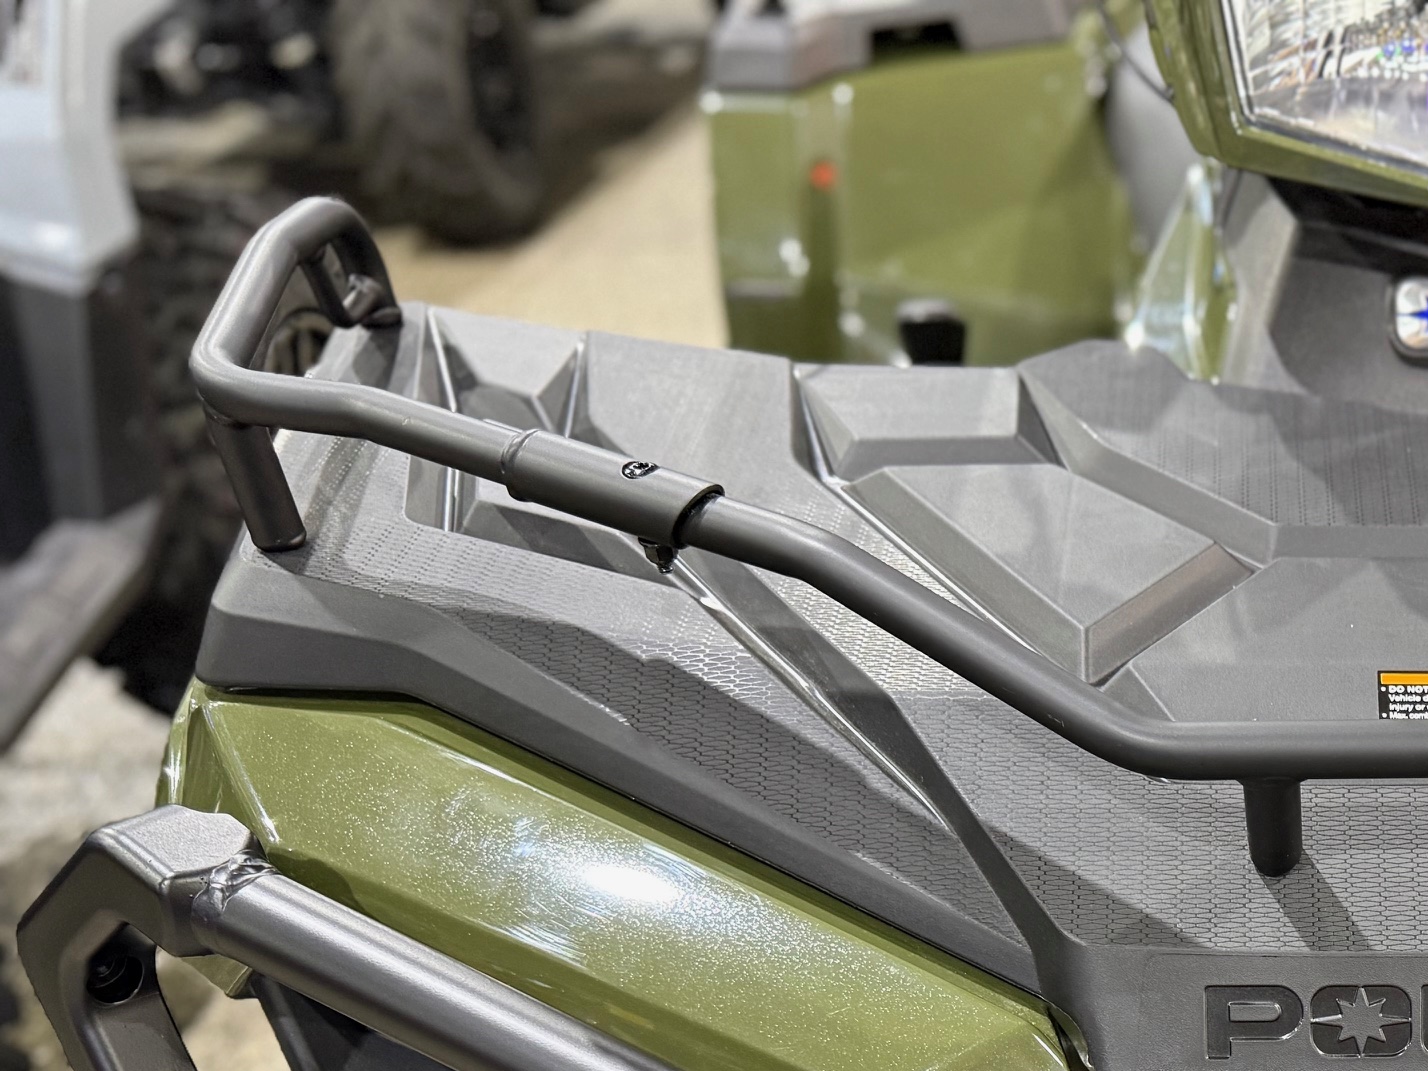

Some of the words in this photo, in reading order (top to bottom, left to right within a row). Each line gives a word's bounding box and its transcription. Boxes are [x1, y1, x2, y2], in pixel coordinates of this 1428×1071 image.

[1388, 685, 1405, 694] DO
[1388, 694, 1421, 702] Vehicle
[1389, 703, 1414, 712] injury
